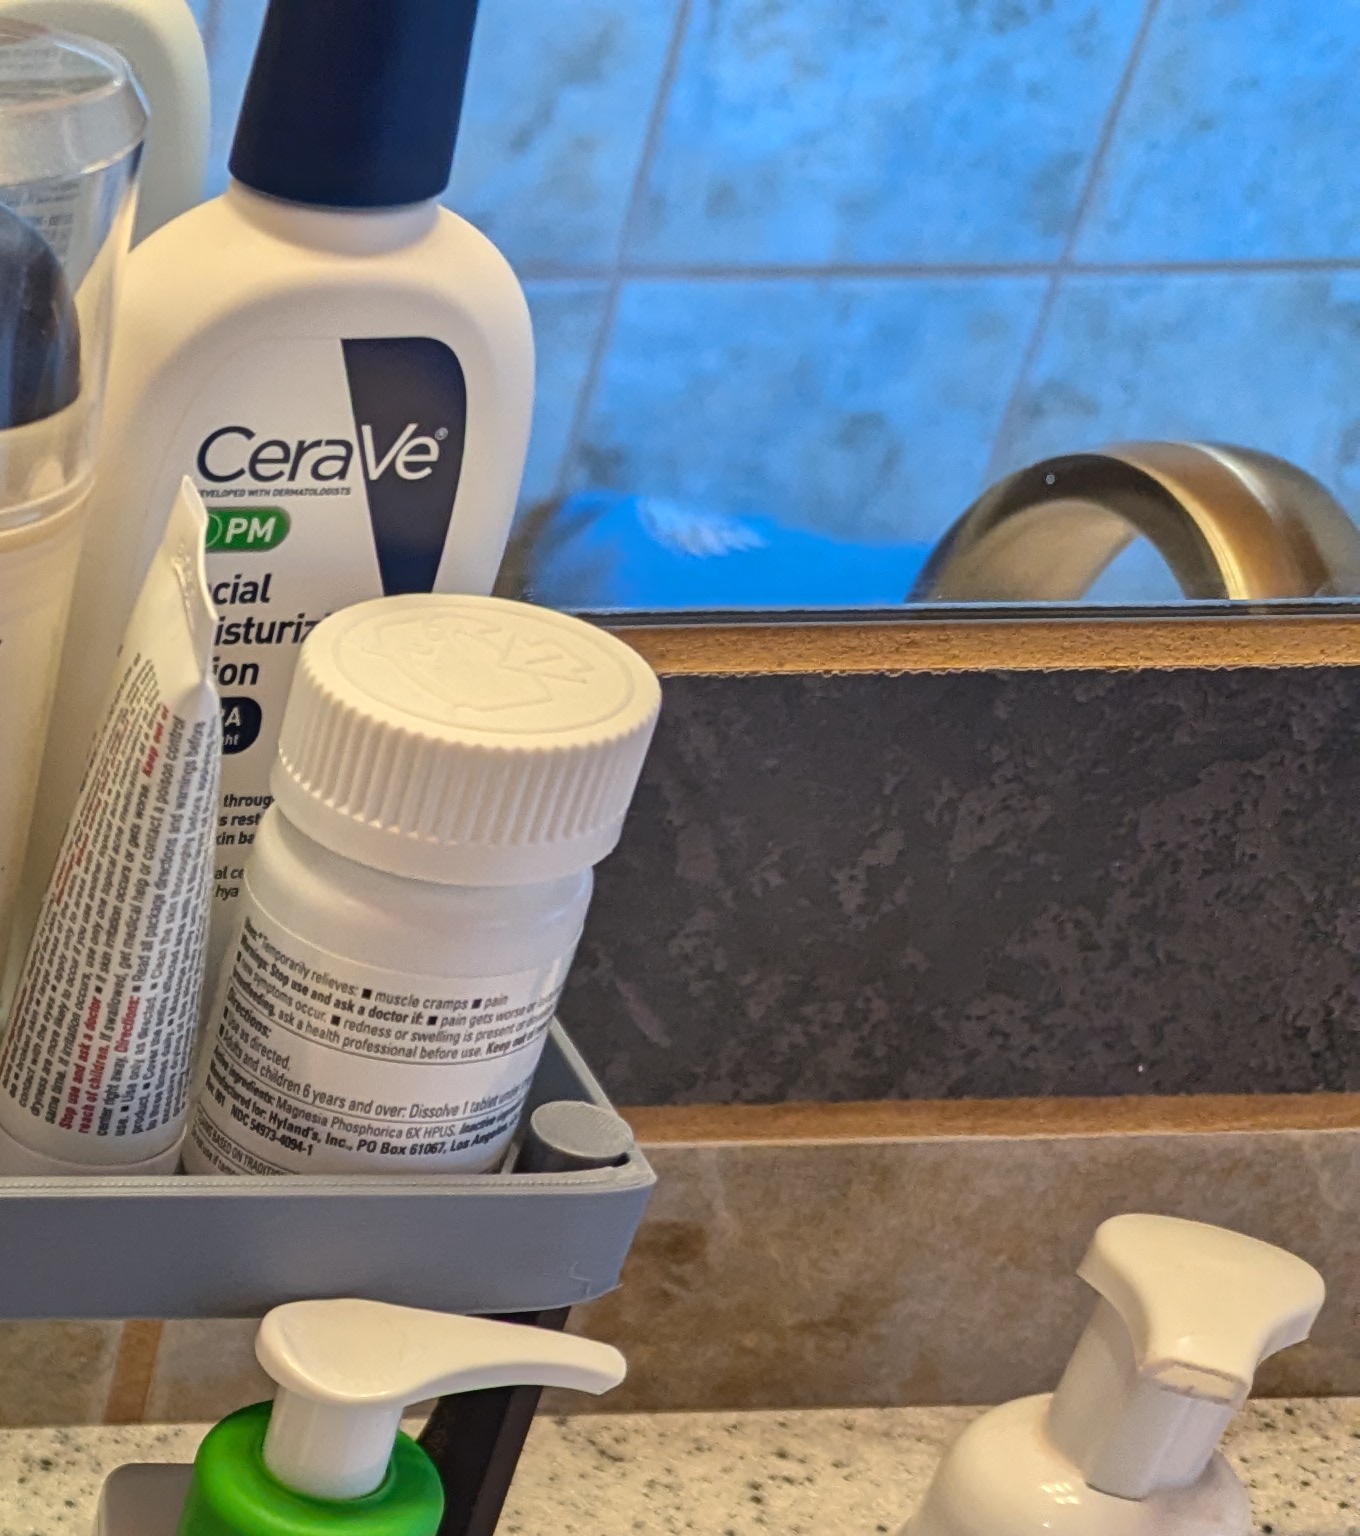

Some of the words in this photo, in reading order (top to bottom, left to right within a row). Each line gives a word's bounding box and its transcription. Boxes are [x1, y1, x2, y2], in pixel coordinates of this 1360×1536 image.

[196, 423, 441, 483] CeraVe
[200, 488, 245, 498] EVELOPED
[247, 488, 270, 497] WITH
[272, 487, 351, 497] DERMATOLOGISTS
[224, 517, 276, 543] PM
[212, 573, 272, 605] cial
[142, 745, 159, 777] Keep
[78, 1104, 95, 1134] reach
[156, 762, 174, 805] poison
[165, 715, 186, 761] control
[84, 996, 100, 1031] doctor
[291, 979, 309, 995] use
[311, 989, 332, 1005] and
[334, 998, 355, 1013] ask
[368, 1005, 408, 1024] doctor
[440, 1014, 466, 1028] pain
[469, 1011, 493, 1028] gets
[374, 991, 419, 1009] muscle
[423, 996, 468, 1012] cramps
[343, 1018, 391, 1038] redness
[395, 1027, 409, 1041] or
[410, 1028, 460, 1046] swelling
[78, 1042, 90, 1062] ask
[342, 1036, 418, 1058] professional
[419, 1044, 458, 1059] before
[72, 1062, 86, 1084] and
[68, 1086, 80, 1104] use
[260, 1064, 301, 1094] children
[303, 1083, 311, 1098] 6
[311, 1089, 346, 1109] years
[348, 1100, 374, 1114] and
[409, 1103, 459, 1119] Dissolve
[59, 1106, 77, 1130] Stop
[231, 1103, 249, 1126] NDC
[275, 1096, 328, 1127] Magnesia
[331, 1115, 402, 1139] Phosphorica
[406, 1127, 422, 1139] 6X
[356, 1140, 377, 1154] PO
[380, 1141, 407, 1155] Box
